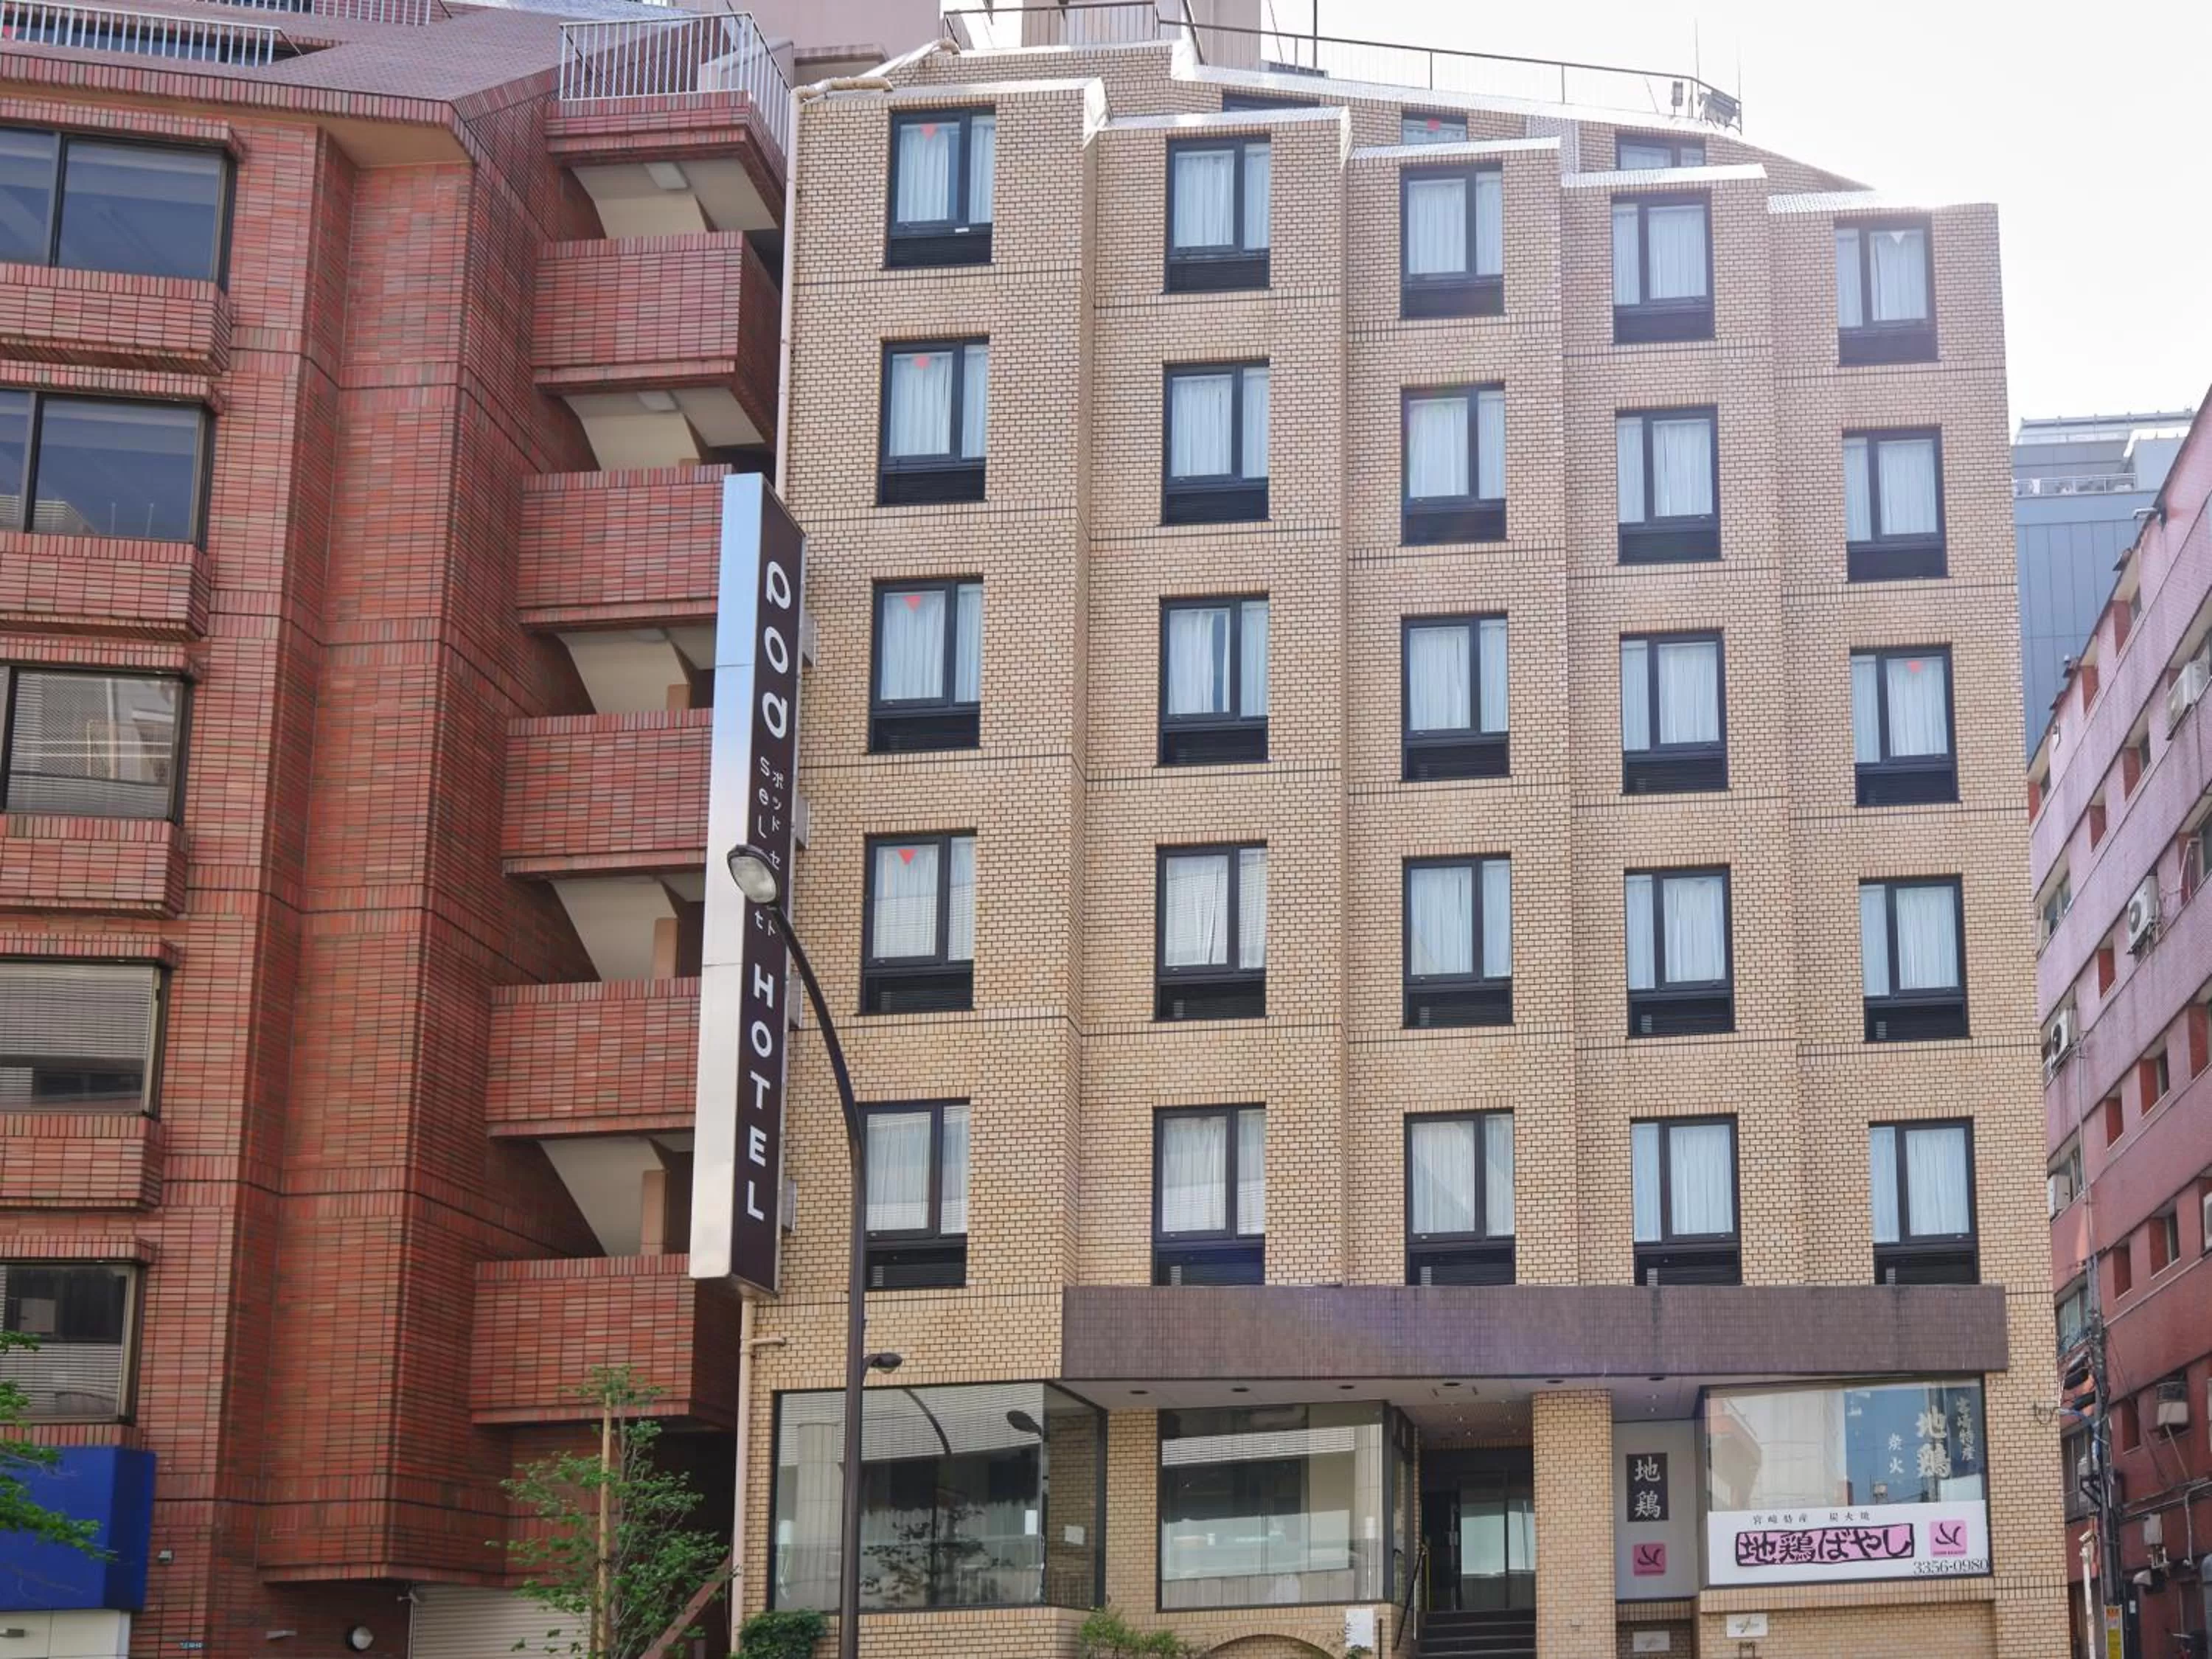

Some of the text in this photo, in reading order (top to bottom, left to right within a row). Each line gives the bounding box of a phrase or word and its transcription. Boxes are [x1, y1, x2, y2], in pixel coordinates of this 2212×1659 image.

[747, 963, 774, 1222] HOTEL
[1634, 1456, 1661, 1519] 地鶏
[1738, 1527, 1913, 1564] 地鶏ばやし
[1913, 1558, 1989, 1575] 3356-0980
